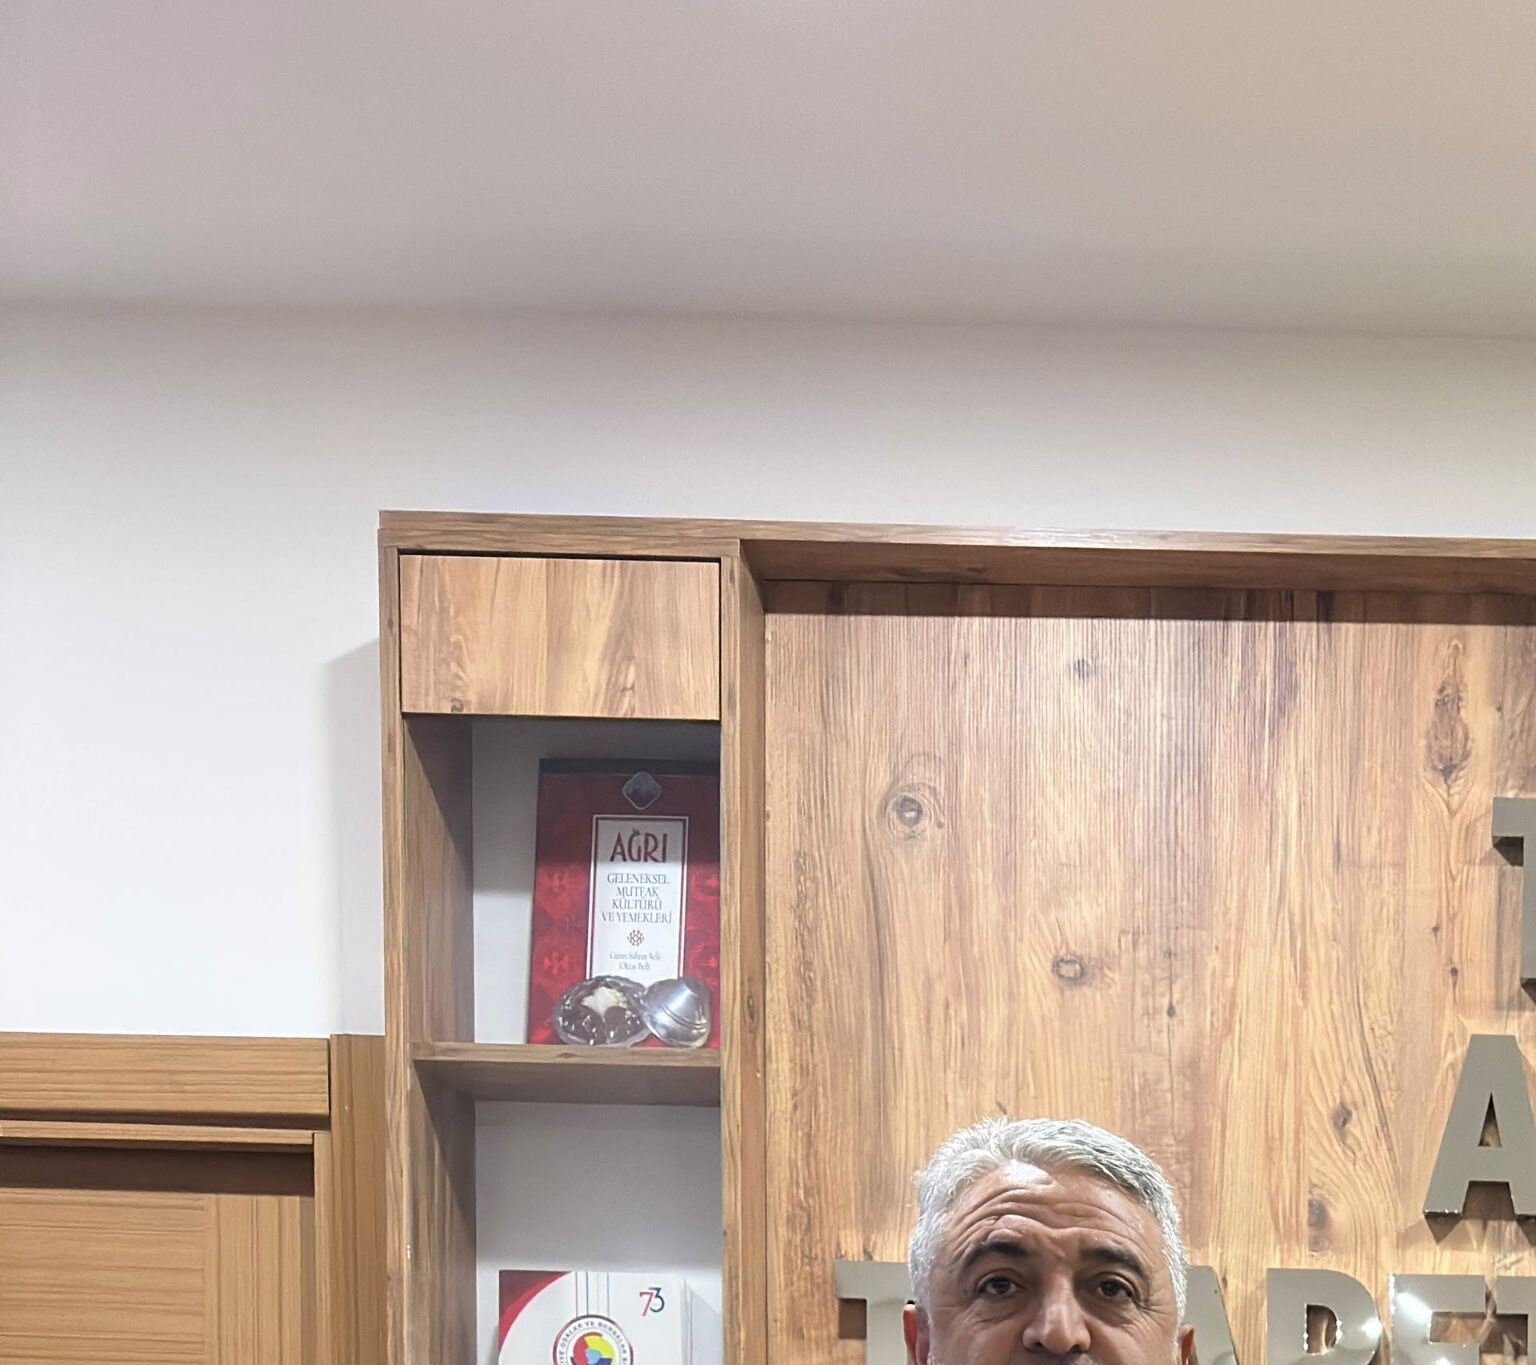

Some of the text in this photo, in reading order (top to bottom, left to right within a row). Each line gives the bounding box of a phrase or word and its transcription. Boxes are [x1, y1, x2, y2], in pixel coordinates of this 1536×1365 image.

[609, 828, 668, 863] AĞRI
[606, 873, 671, 885] GELENEKSEL
[616, 886, 660, 898] MUTFAK
[611, 898, 663, 910] KÜLTÜRÜ
[601, 911, 673, 924] VE YEMEKLERİ
[639, 1287, 665, 1317] 73
